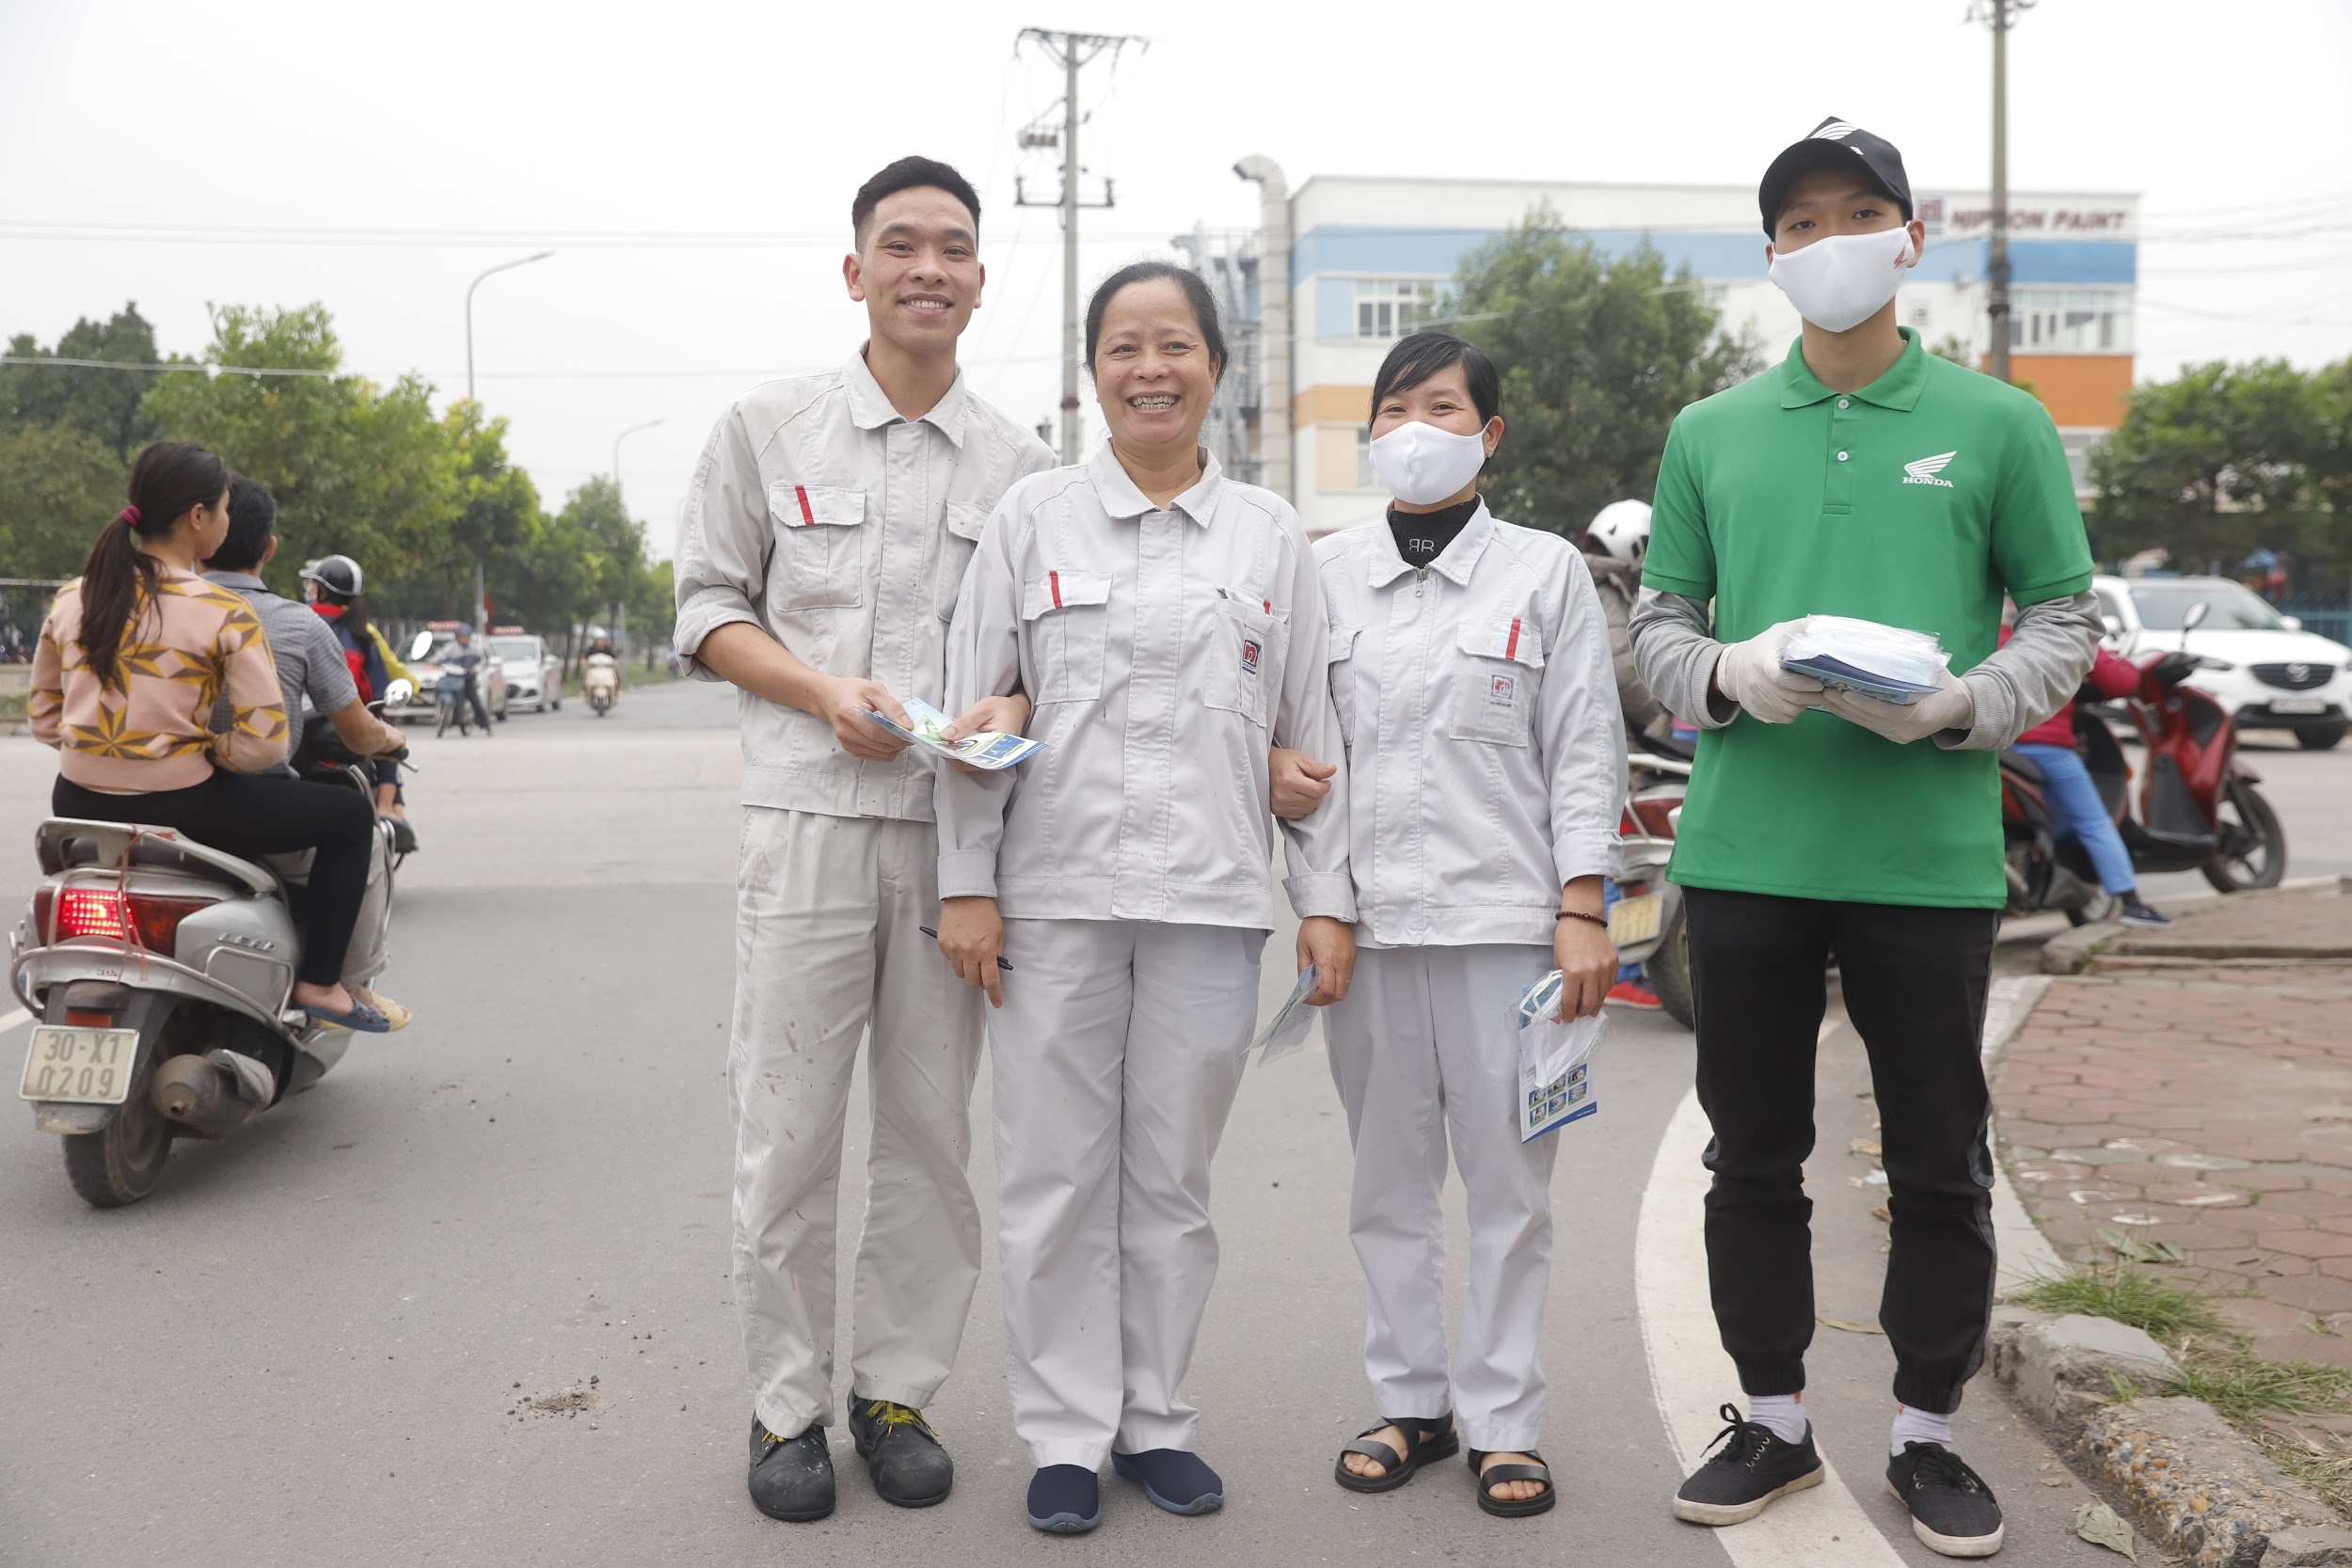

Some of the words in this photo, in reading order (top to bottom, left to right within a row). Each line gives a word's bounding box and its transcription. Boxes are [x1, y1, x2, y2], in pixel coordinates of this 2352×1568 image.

[1952, 209, 2044, 231] NIPON
[2052, 209, 2126, 231] PAINT
[1902, 476, 1954, 488] HONDA
[43, 1032, 120, 1065] 30-X1
[37, 1065, 115, 1098] 0209
